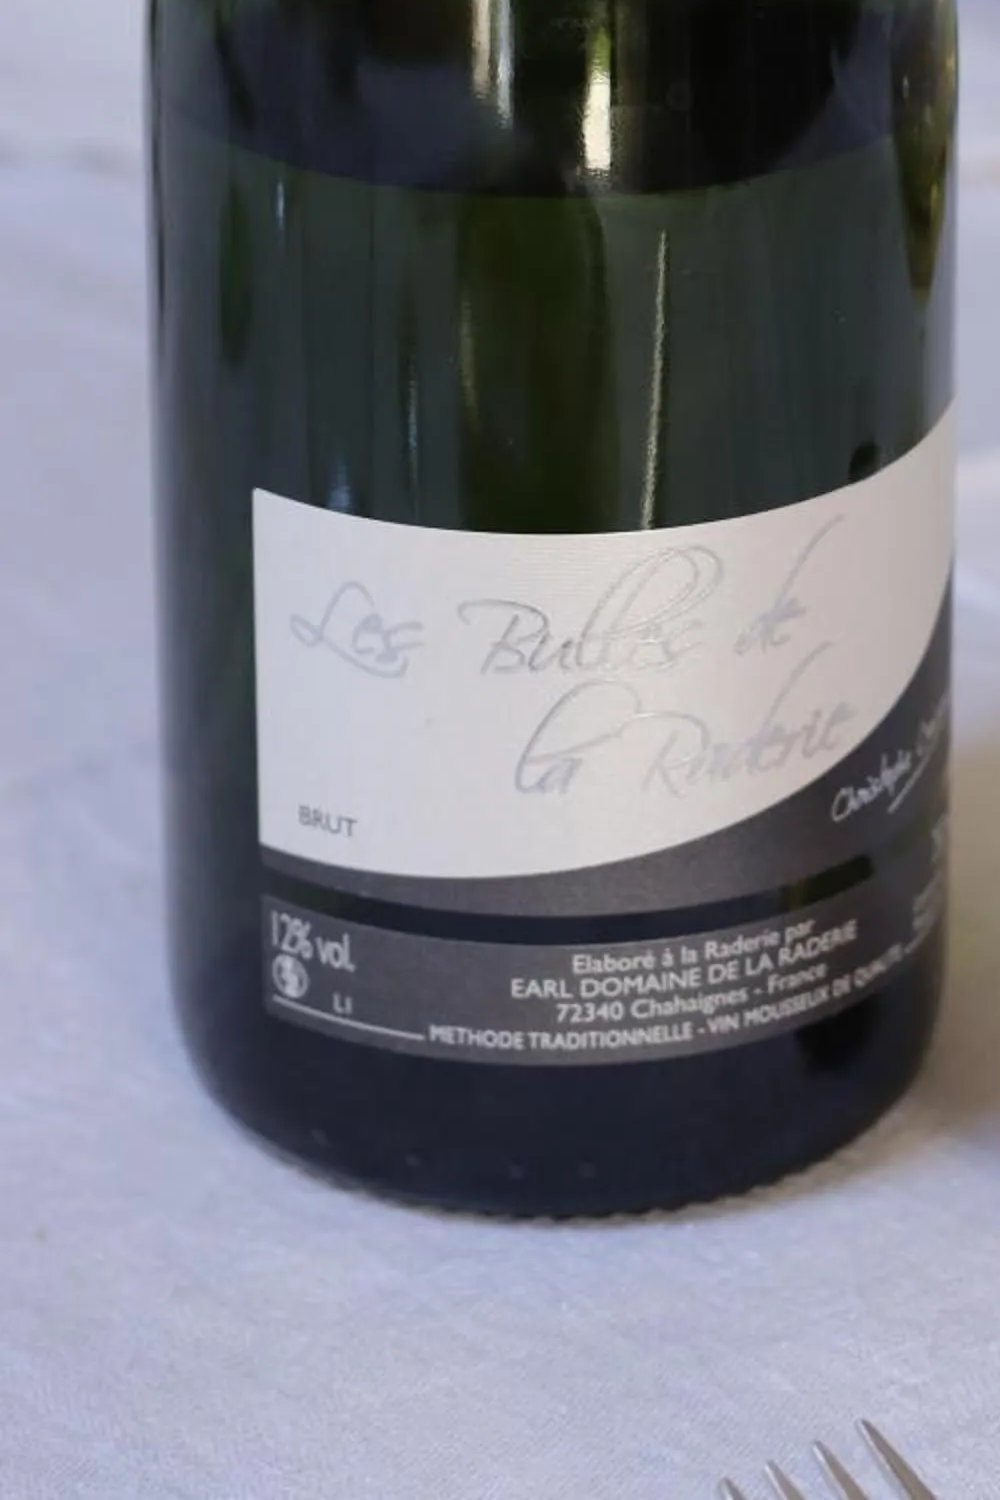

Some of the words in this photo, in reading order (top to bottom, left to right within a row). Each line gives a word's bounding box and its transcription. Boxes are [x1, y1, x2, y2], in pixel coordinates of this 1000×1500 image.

[298, 804, 358, 838] BRUT
[510, 977, 573, 999] EARL
[579, 967, 702, 999] DOMAINE
[707, 959, 740, 985] DE
[745, 952, 775, 977] LA
[777, 918, 859, 968] RADERIE
[680, 945, 698, 964] la
[703, 928, 781, 962] Raderie
[555, 1000, 624, 1025] 72340
[630, 986, 749, 1021] Chahaignes
[767, 962, 829, 996] France
[428, 1024, 526, 1051] METHODE
[526, 1021, 693, 1050] TRADITIONNELLE
[706, 1013, 740, 1036] VIN
